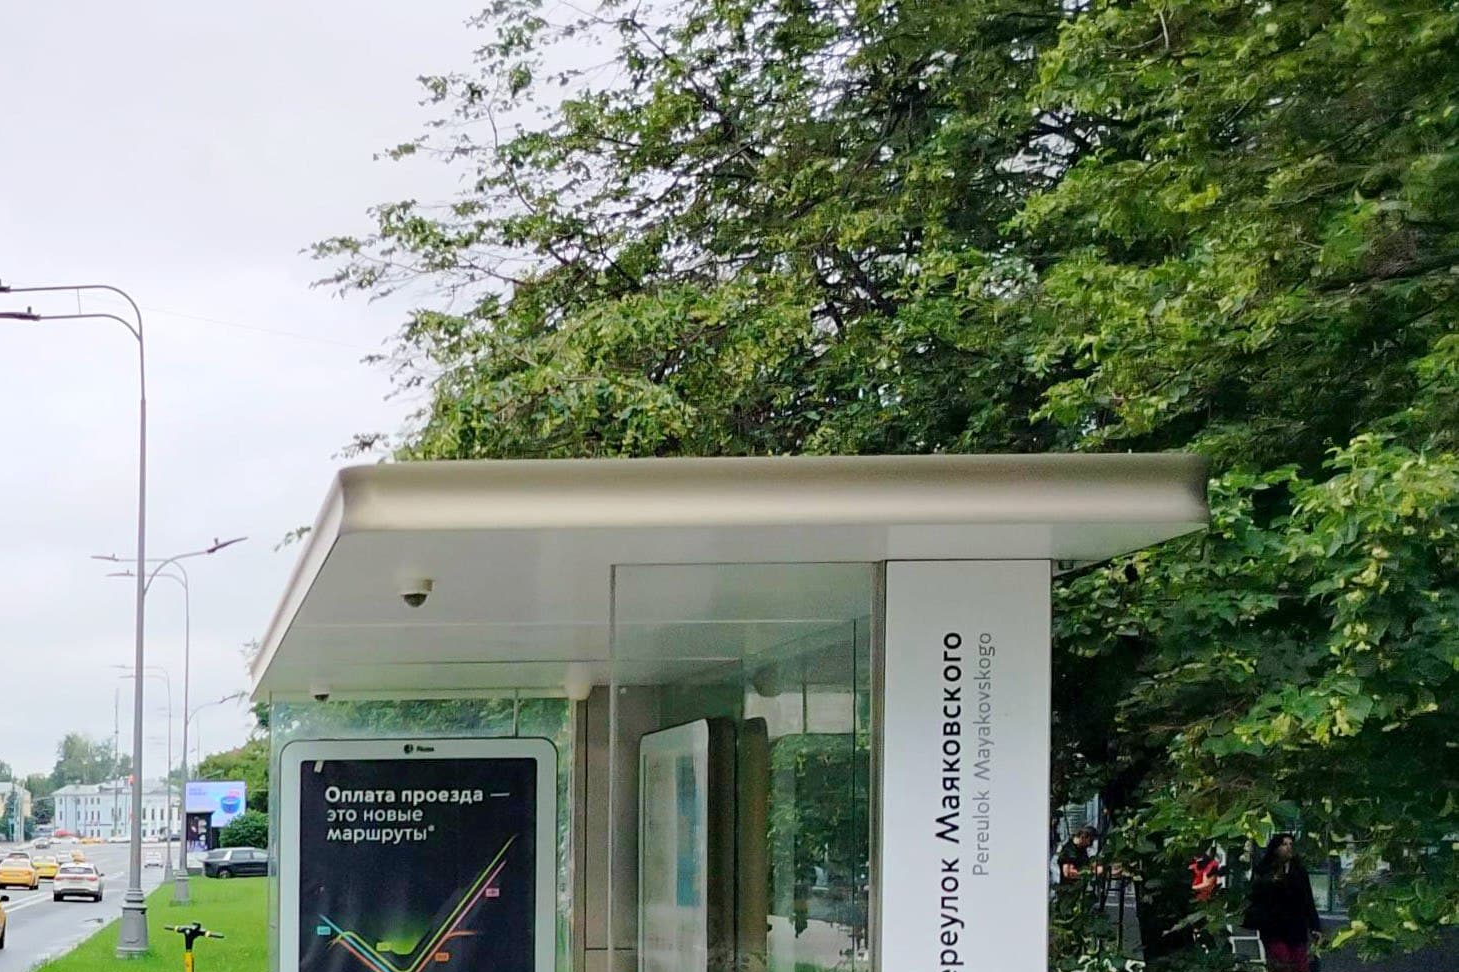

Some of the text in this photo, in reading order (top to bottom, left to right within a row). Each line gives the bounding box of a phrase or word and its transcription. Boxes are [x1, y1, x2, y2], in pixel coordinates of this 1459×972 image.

[324, 786, 396, 803] Оплата
[401, 788, 484, 806] проезда
[935, 632, 963, 844] Маяковского
[972, 633, 996, 876] Pereulok Mayakovskogo
[326, 809, 424, 822] это новые
